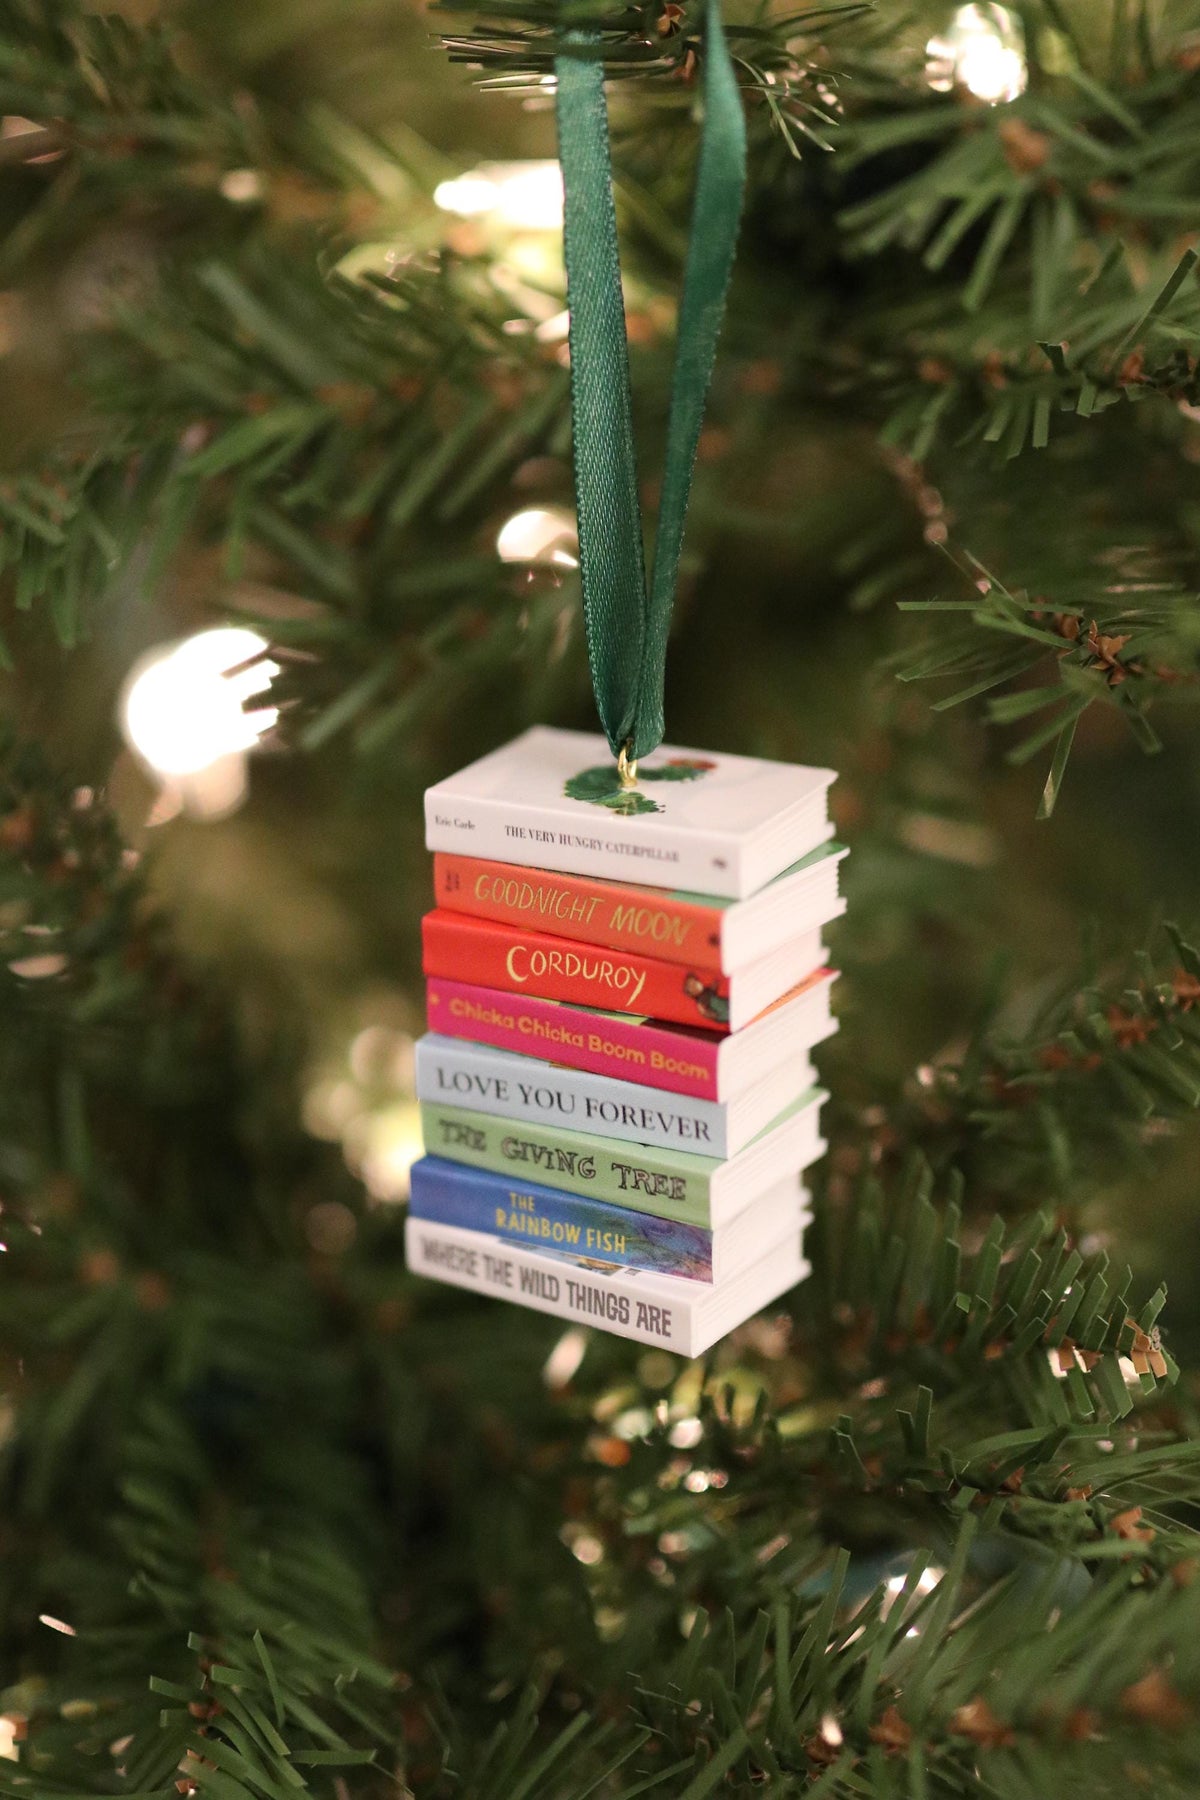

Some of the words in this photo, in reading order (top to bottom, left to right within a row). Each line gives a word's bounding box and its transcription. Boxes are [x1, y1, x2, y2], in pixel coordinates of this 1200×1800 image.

[505, 825, 526, 839] THE
[528, 829, 557, 843] VERY
[559, 833, 602, 851] HUNGRY
[605, 841, 680, 863] CATERPILLAR
[474, 874, 604, 924] GOODNIGHT
[609, 905, 695, 946] MOON
[449, 997, 514, 1029] Chicka
[518, 1016, 584, 1047] Chicka
[588, 1035, 646, 1064] Boom
[650, 1051, 709, 1080] Boom
[436, 1066, 509, 1101] LOVE
[518, 1083, 576, 1114] YOU
[585, 1097, 711, 1142] FOREVER
[439, 1119, 487, 1152] THE
[502, 1136, 596, 1179] GIVING
[611, 1162, 686, 1200] TREE
[495, 1208, 581, 1244] RAINBOW
[586, 1227, 626, 1255] FISH
[509, 1191, 535, 1212] THE
[420, 1237, 478, 1277] WHERE
[483, 1253, 514, 1288] THE
[519, 1264, 560, 1302] WILD
[566, 1279, 630, 1325] THINGS
[636, 1301, 672, 1338] ARE
